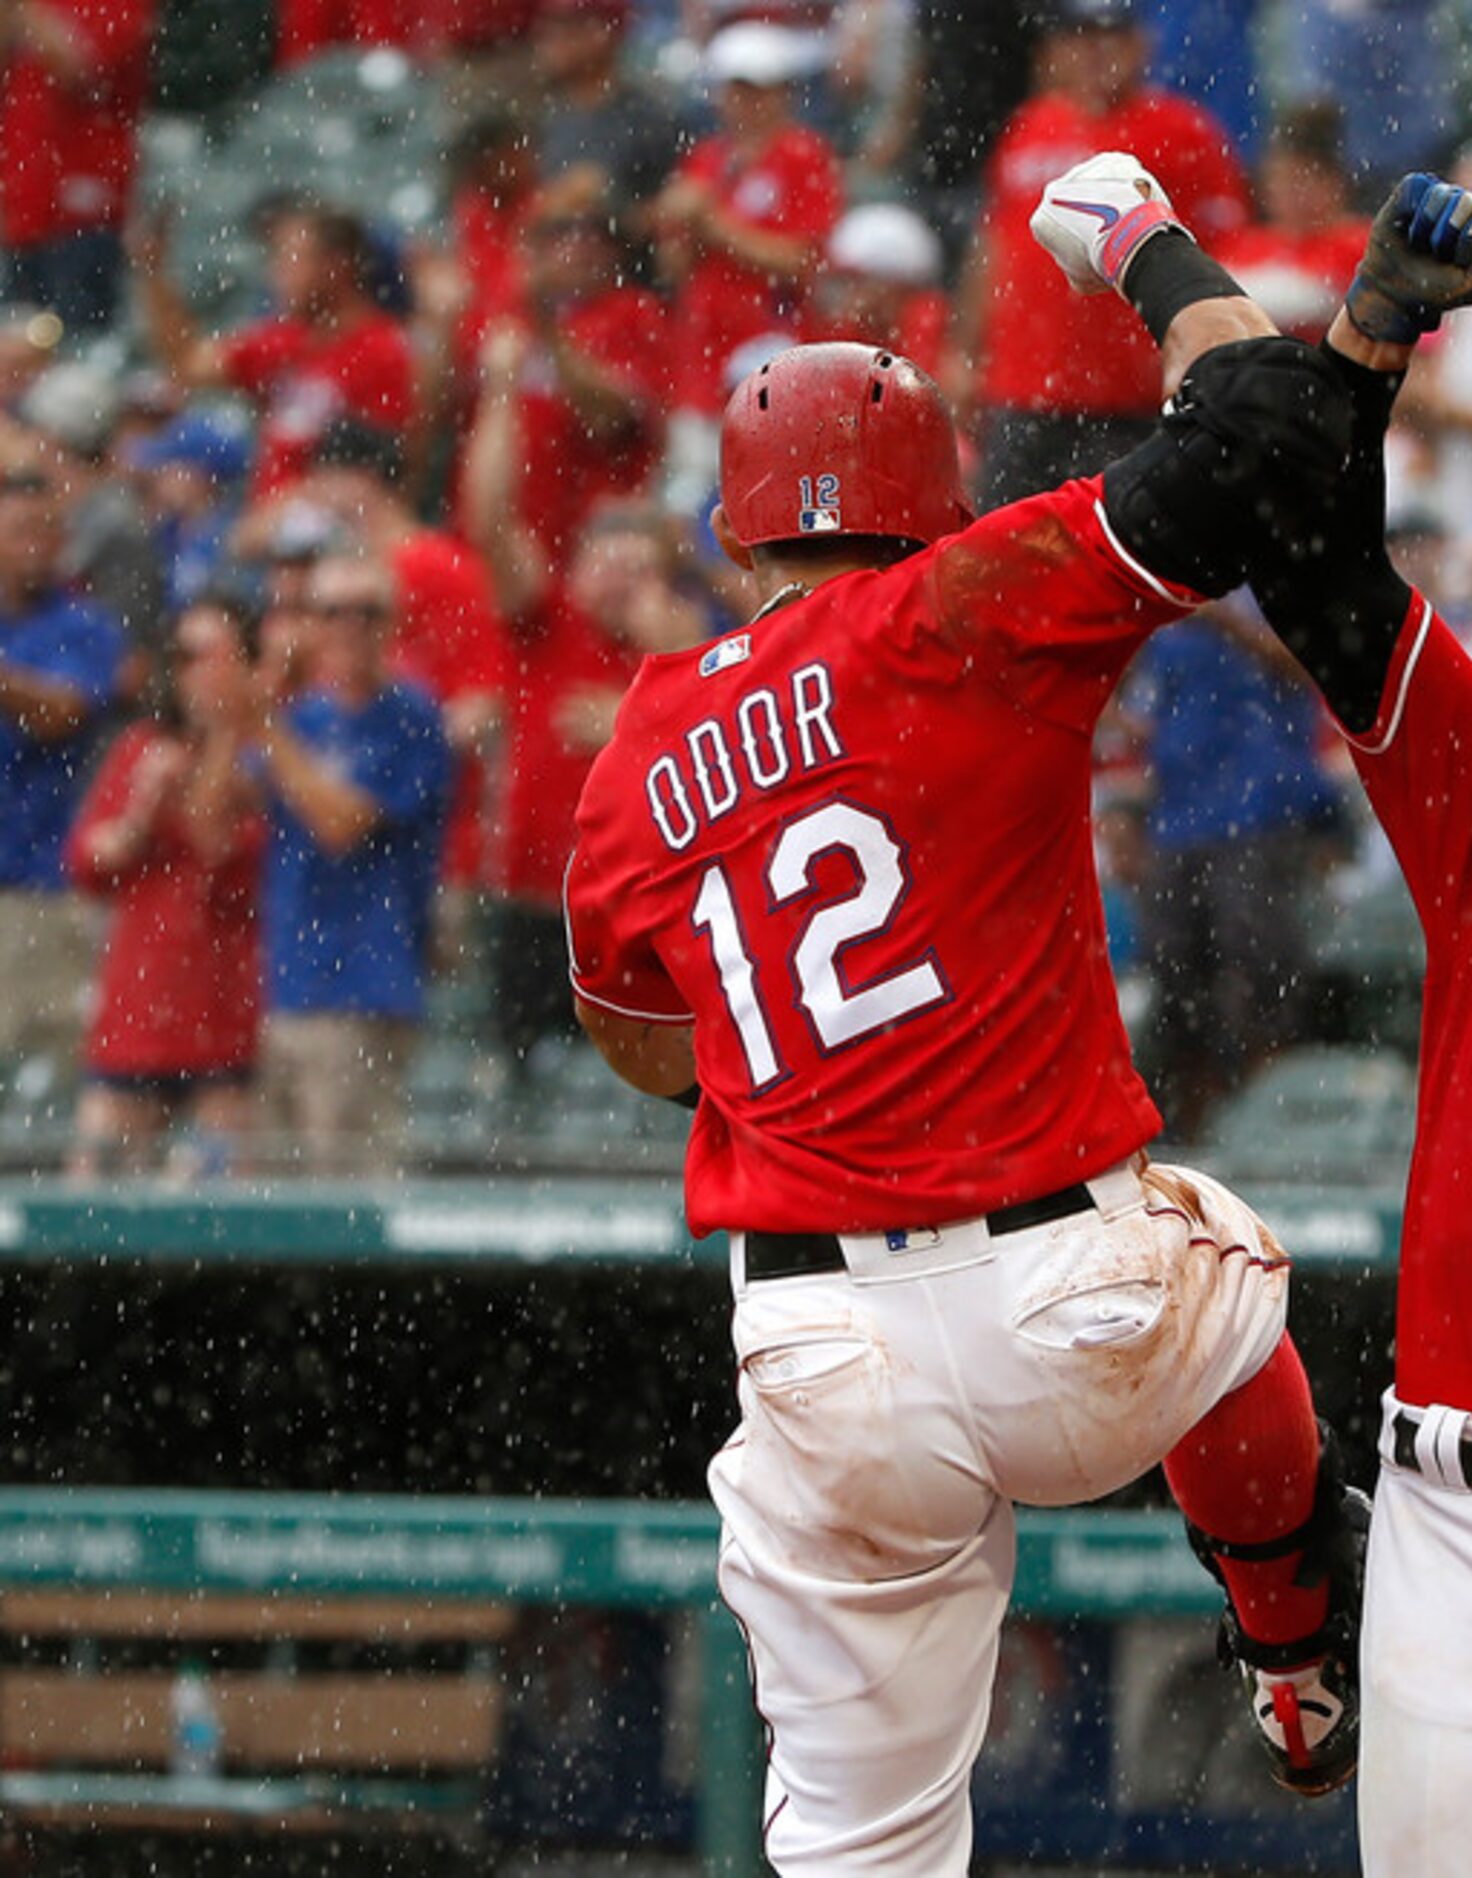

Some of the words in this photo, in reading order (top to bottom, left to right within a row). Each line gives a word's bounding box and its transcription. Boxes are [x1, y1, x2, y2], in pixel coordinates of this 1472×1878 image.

[799, 474, 840, 507] 12
[644, 660, 846, 854] ODOR
[690, 796, 951, 1094] 12
